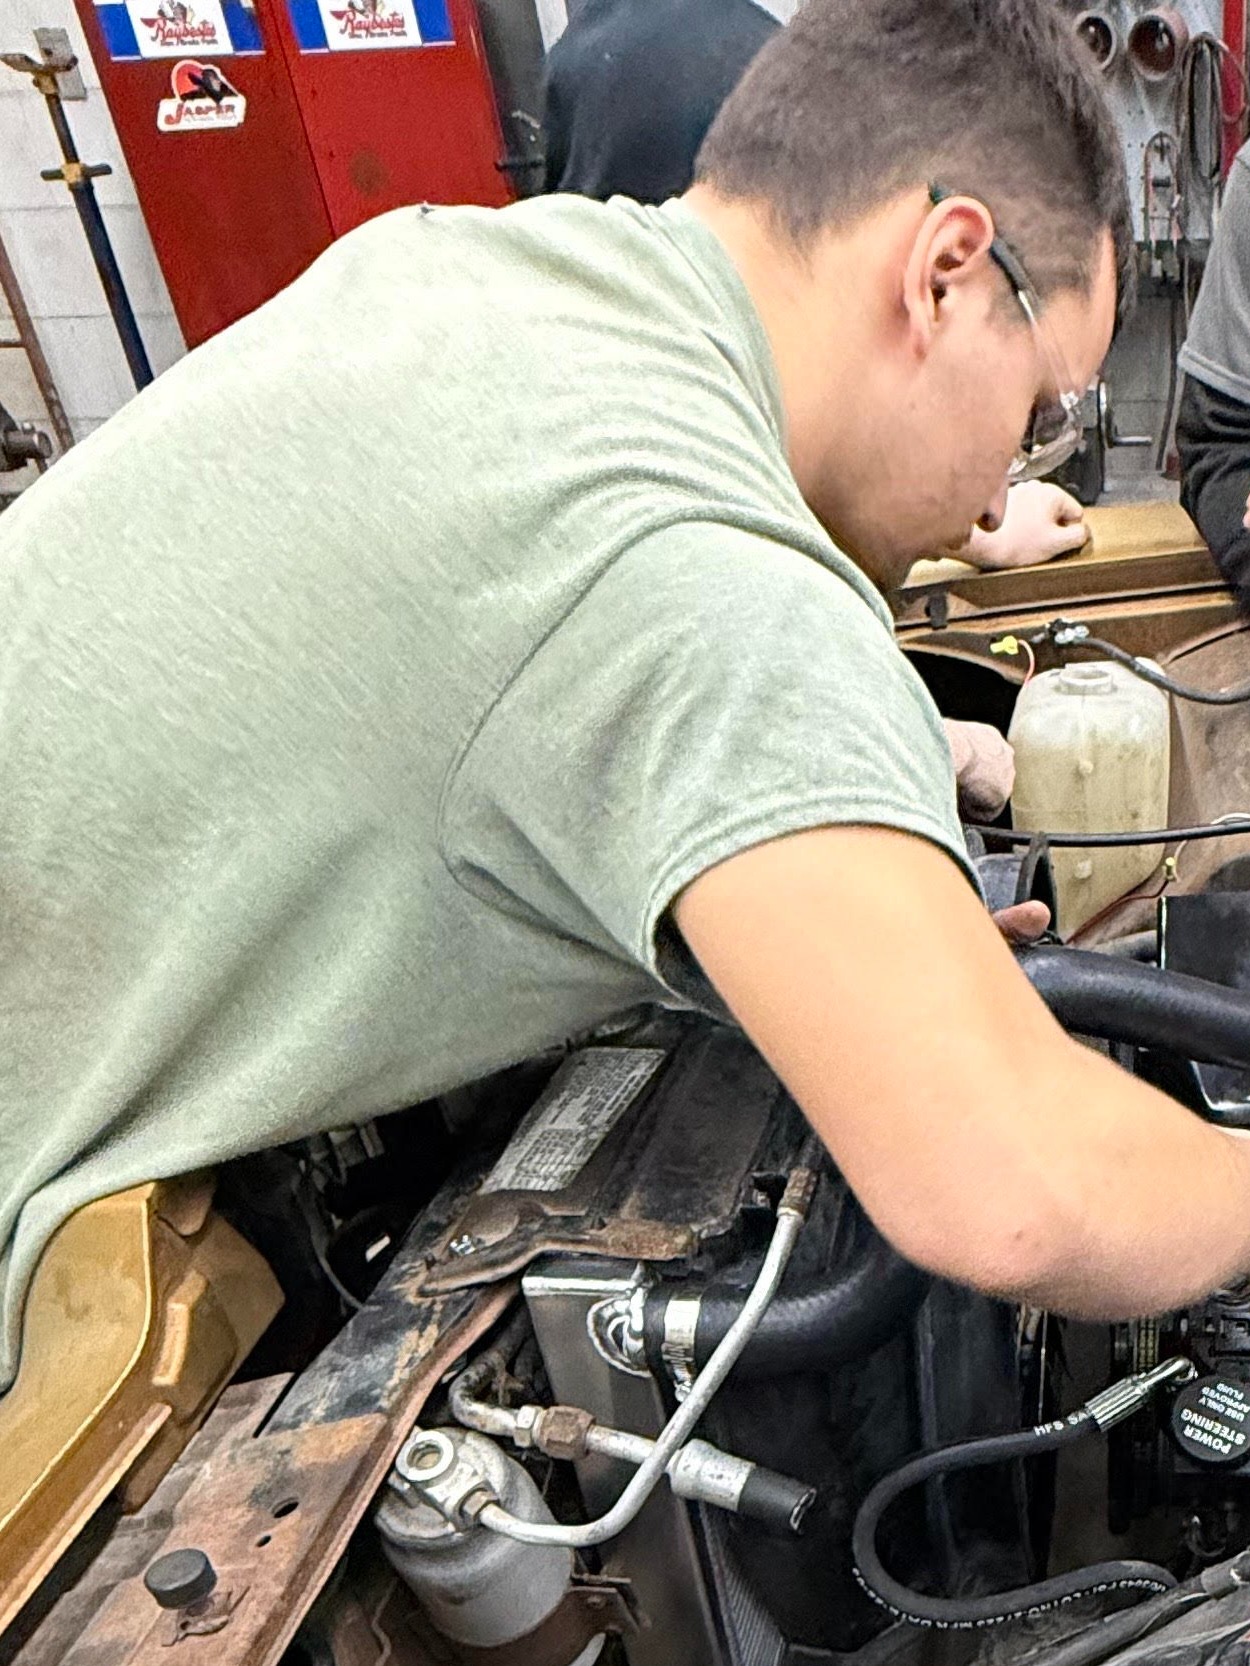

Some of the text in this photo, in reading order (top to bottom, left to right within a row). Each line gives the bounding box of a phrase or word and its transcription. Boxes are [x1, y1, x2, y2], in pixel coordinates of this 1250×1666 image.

[164, 102, 236, 125] JASPER
[1216, 1383, 1244, 1401] FLUID
[1198, 1396, 1245, 1422] USE ONLY
[1181, 1408, 1246, 1445] STEERING
[1183, 1424, 1231, 1454] POWER
